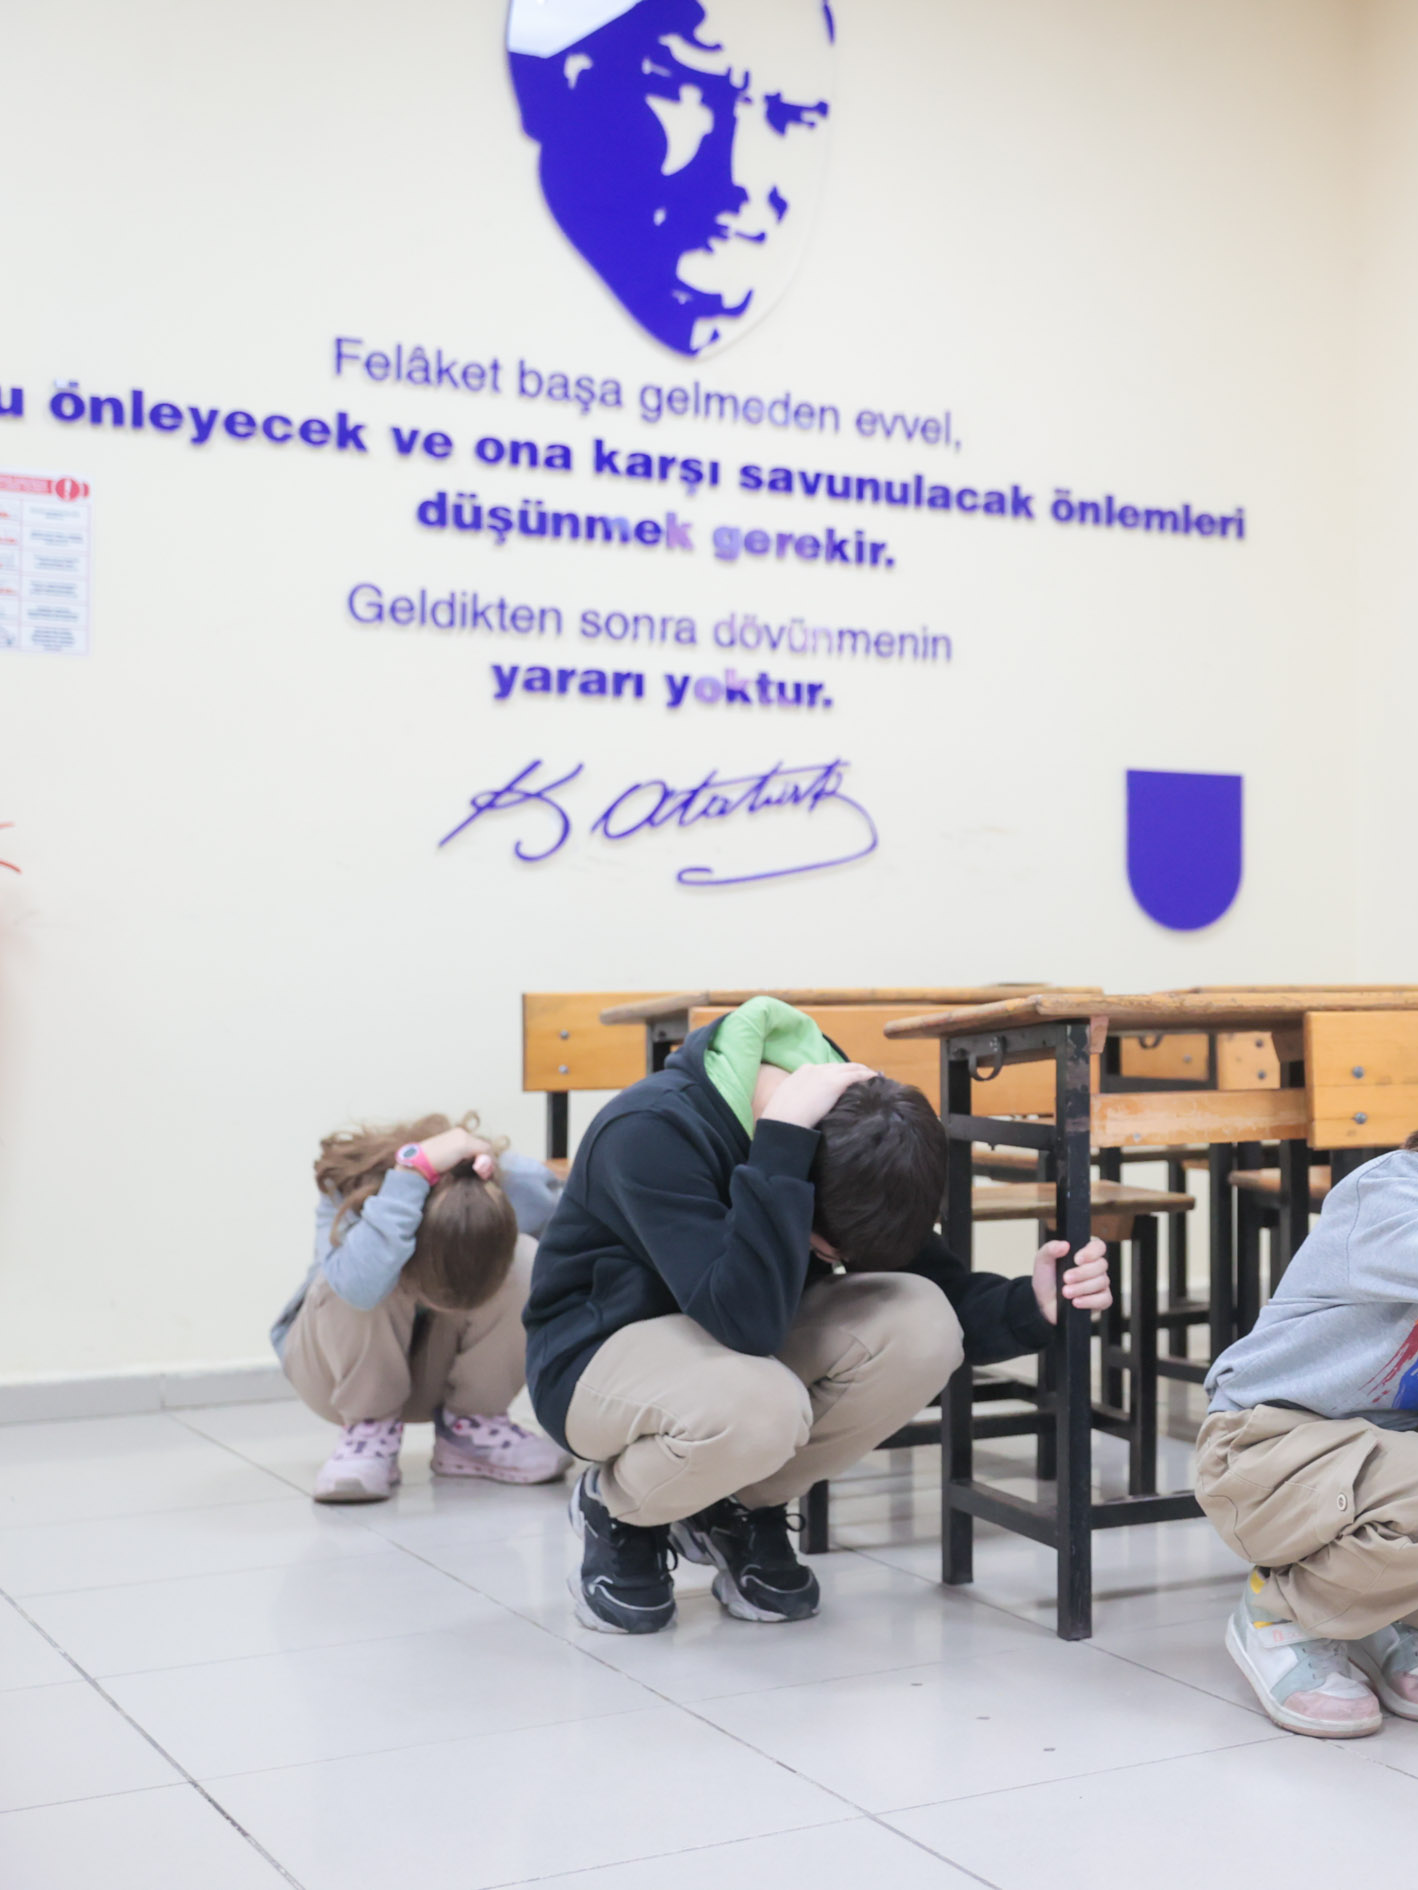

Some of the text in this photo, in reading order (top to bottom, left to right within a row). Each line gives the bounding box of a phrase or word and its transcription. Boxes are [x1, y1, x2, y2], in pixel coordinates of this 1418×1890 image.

[334, 335, 963, 453] Felâket başa gelmeden evvel,
[48, 380, 369, 453] önleyecek
[390, 425, 455, 460] ve
[473, 435, 574, 472] ona
[592, 437, 721, 496] karşı
[738, 463, 1036, 520] savunulacak
[1049, 487, 1246, 540] önlemleri
[415, 491, 896, 568] düşünmek gerekir.
[346, 582, 954, 662] Geldikten sonra dövünmenin
[490, 663, 835, 709] yararı yoktur.
